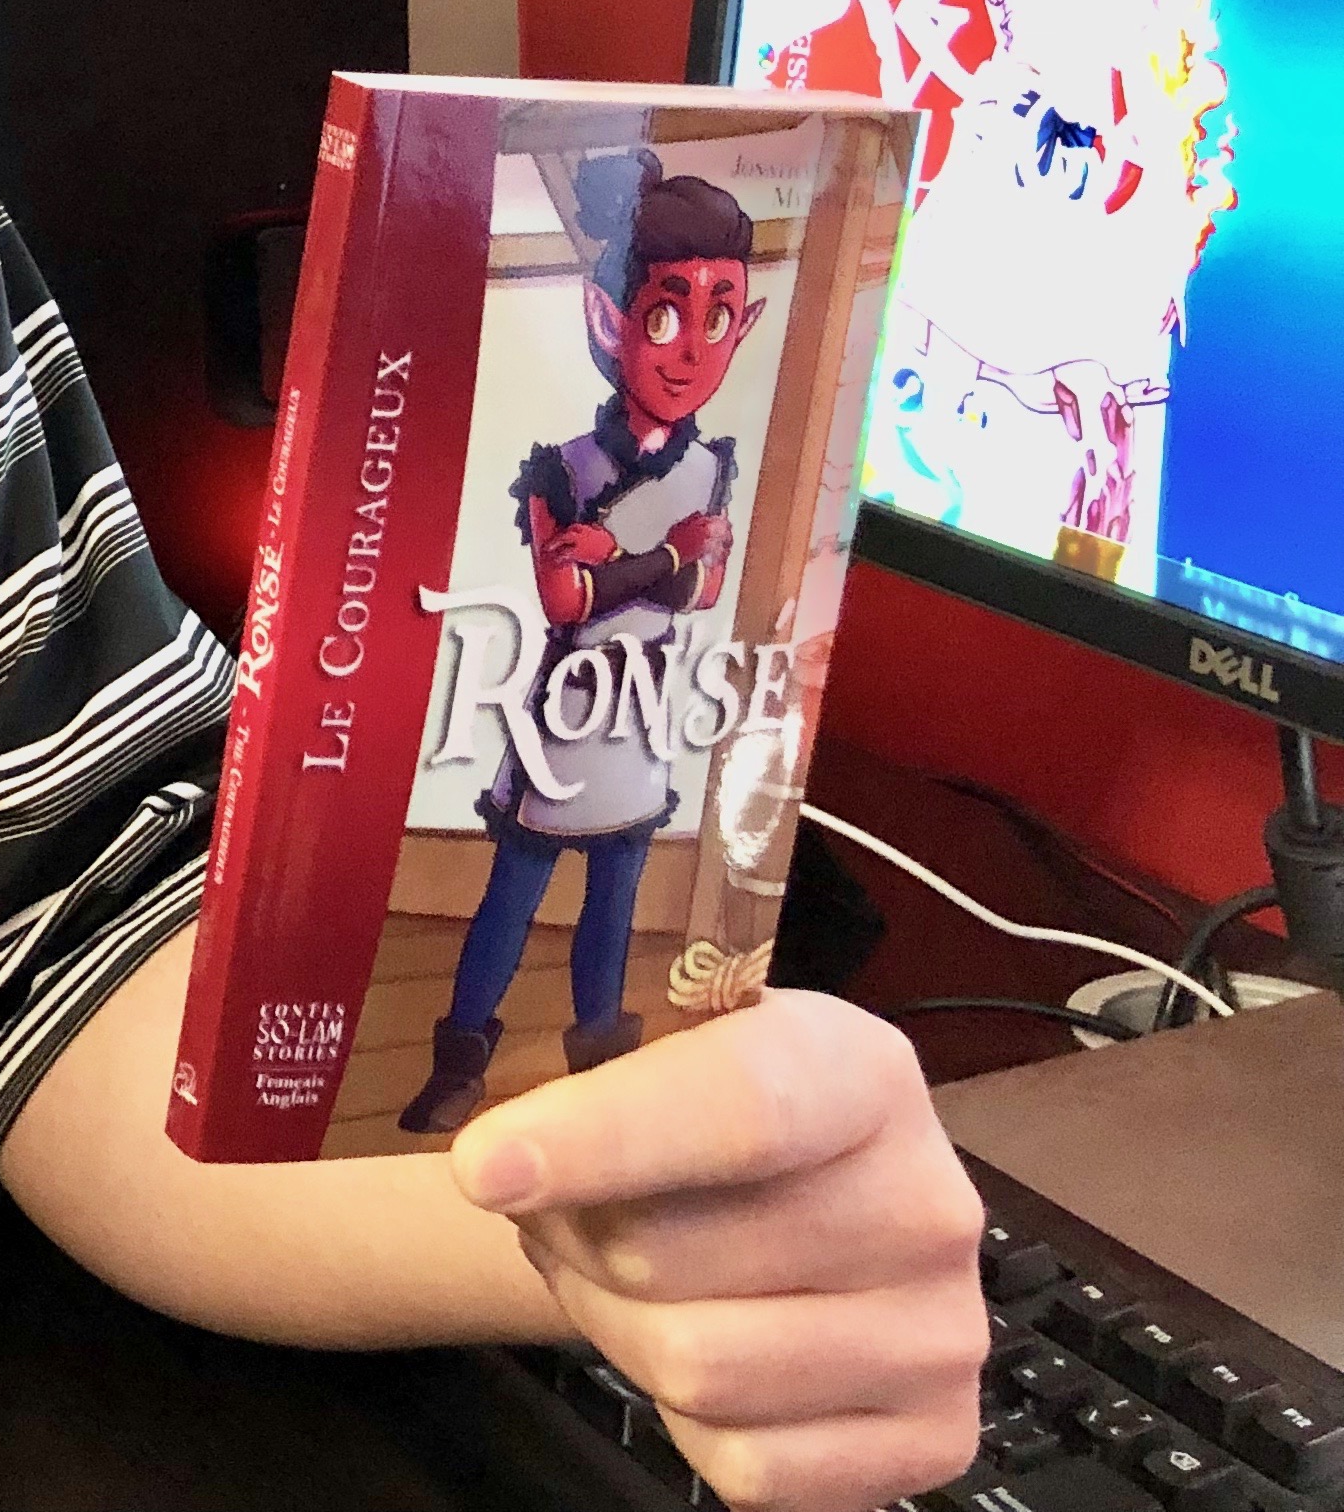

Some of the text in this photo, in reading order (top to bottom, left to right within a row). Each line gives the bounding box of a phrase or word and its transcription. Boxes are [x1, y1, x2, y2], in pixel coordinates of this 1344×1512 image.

[301, 349, 413, 775] LE COURAGEUX
[1189, 636, 1279, 705] DELL
[259, 1002, 345, 1020] CONTES
[252, 1044, 339, 1062] STORIES
[255, 1091, 319, 1109] Anglais
